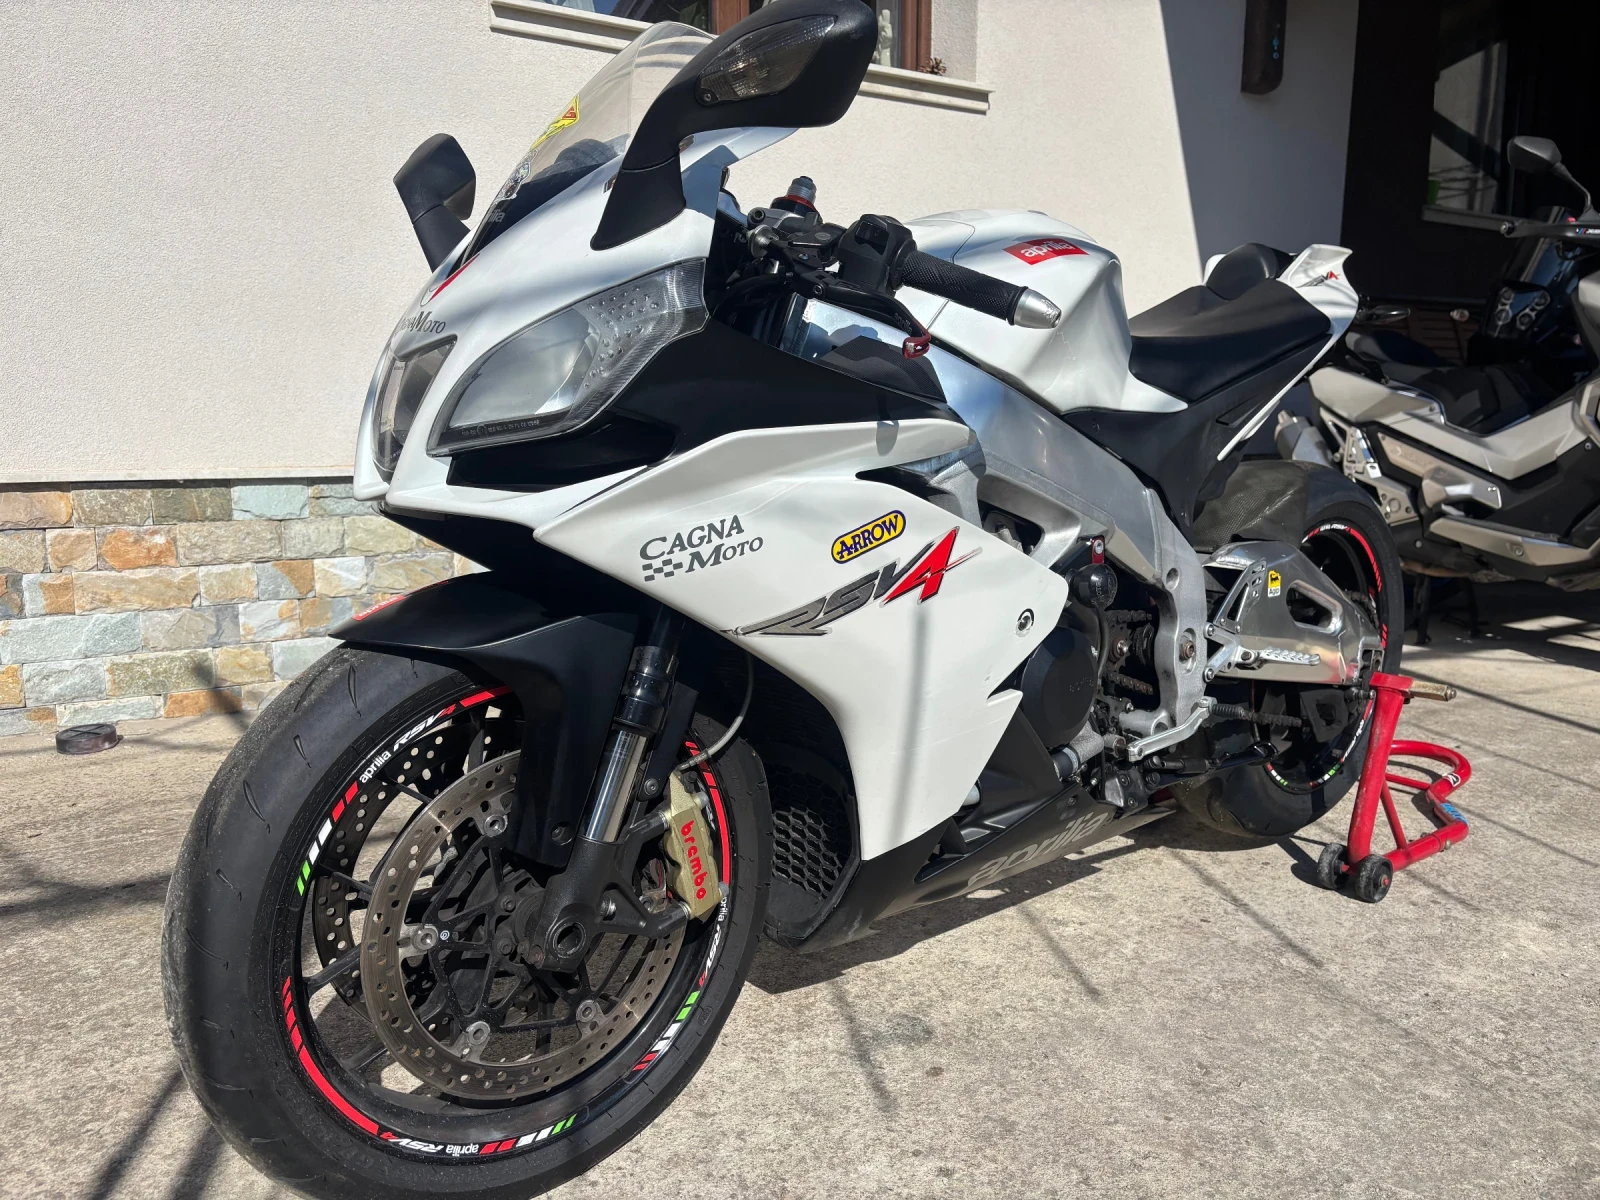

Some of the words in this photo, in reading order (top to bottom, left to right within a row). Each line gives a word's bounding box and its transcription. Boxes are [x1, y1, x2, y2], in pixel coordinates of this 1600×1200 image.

[1020, 240, 1076, 258] aprilia
[639, 514, 745, 561] CAGNA
[684, 536, 764, 574] MOTO
[836, 514, 899, 560] ARROW
[738, 527, 982, 636] RSV4
[359, 750, 392, 784] aprilia
[393, 703, 457, 752] RSV4
[680, 820, 708, 900] brembo
[967, 811, 1109, 887] aprilia
[379, 1131, 445, 1153] RSV4
[445, 1142, 479, 1157] aprilia
